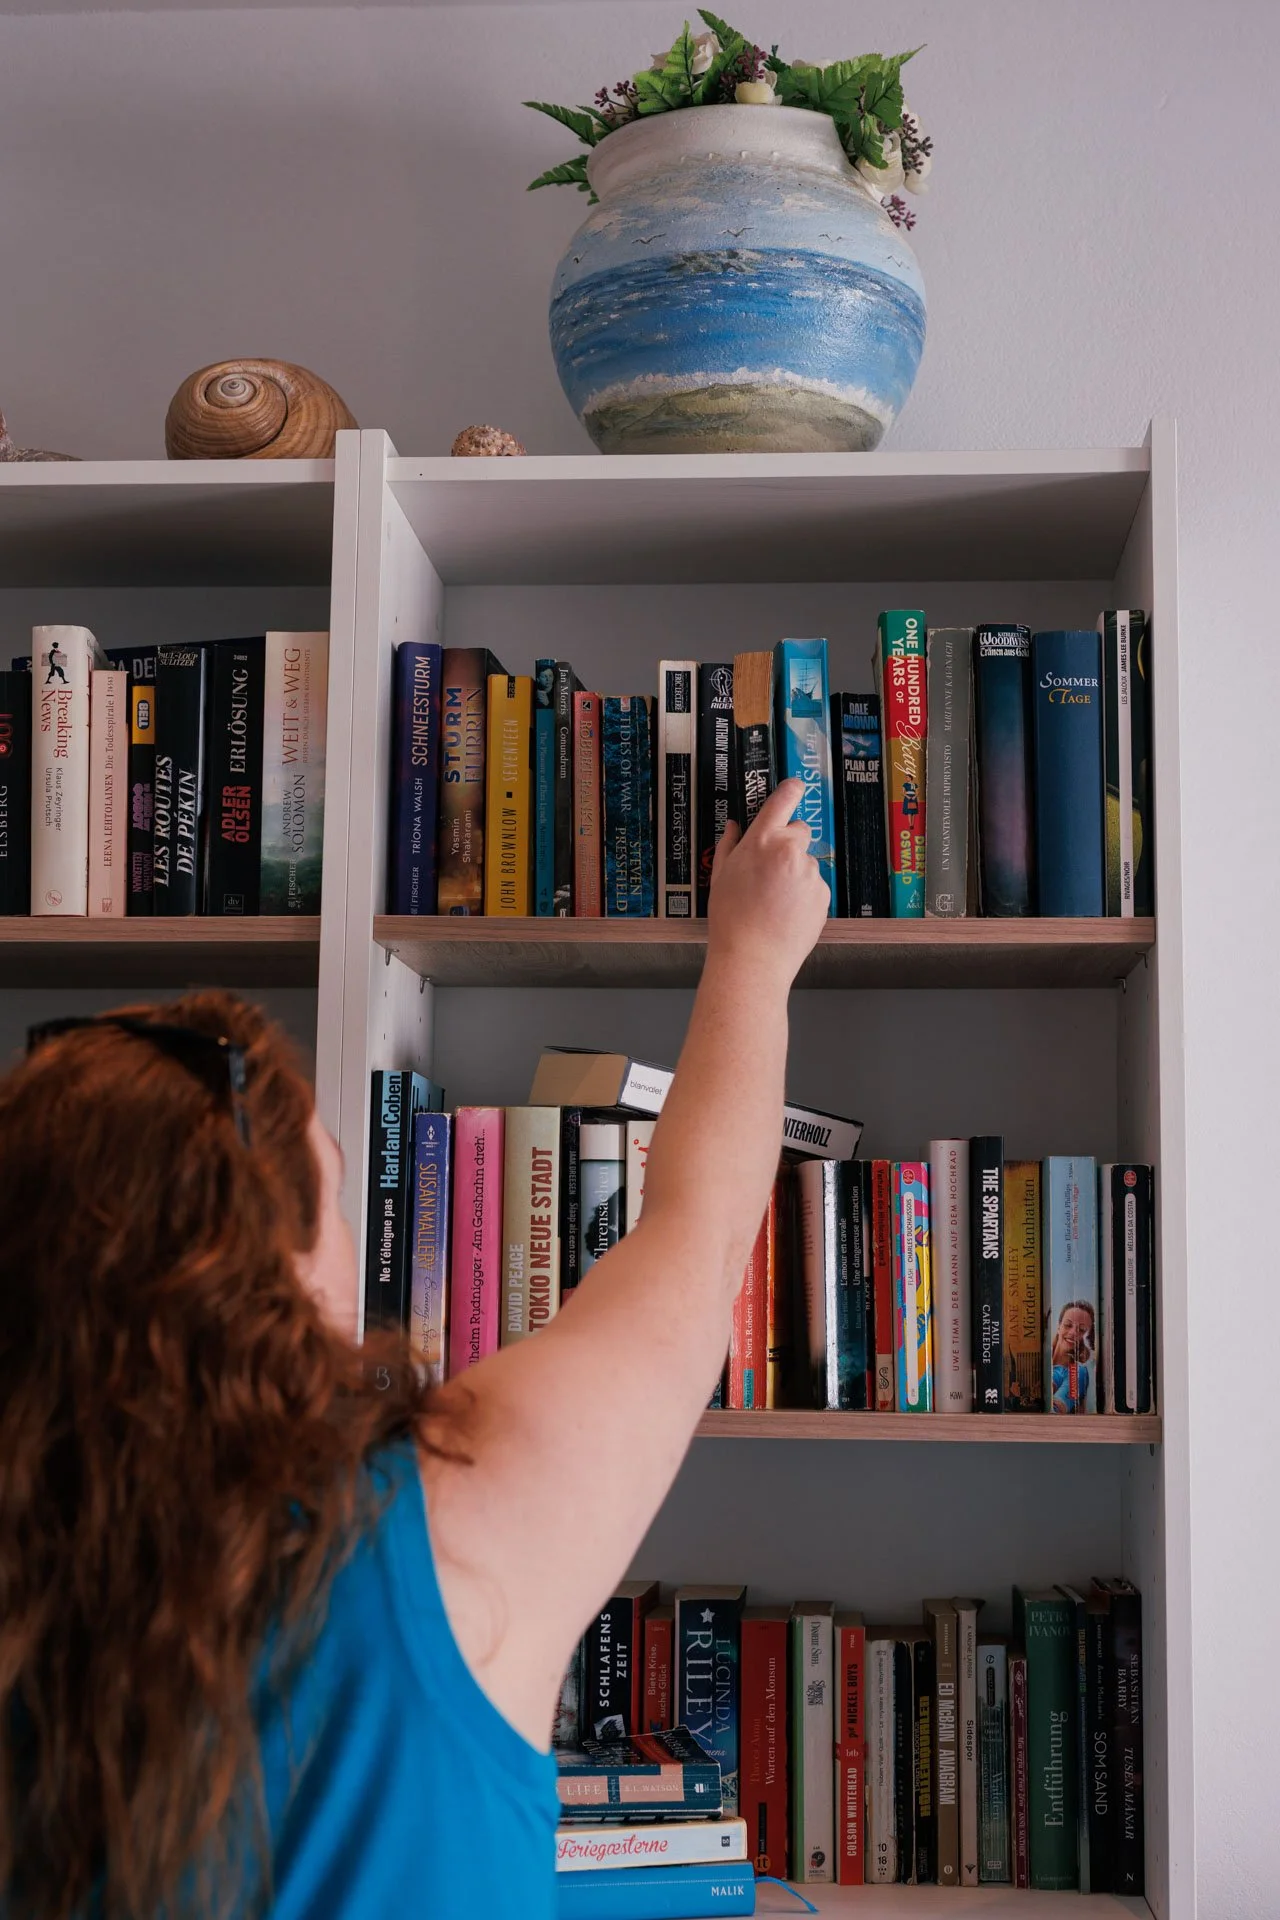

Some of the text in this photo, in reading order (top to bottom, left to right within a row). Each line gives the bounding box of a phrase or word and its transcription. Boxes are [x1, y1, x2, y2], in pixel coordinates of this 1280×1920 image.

[980, 632, 1030, 646] WOODIWISS
[980, 646, 1004, 657] Tränen
[905, 617, 922, 726] ONE HUNDRED
[1039, 671, 1099, 689] SOMMER
[1048, 688, 1092, 704] TAGE
[41, 689, 56, 732] News
[54, 689, 73, 759] Breaking
[139, 702, 148, 728] BELL
[227, 668, 249, 774] ERLÖSUNG
[281, 648, 301, 766] WEIT & WEG
[444, 687, 462, 784] STURM
[464, 687, 483, 783] FLIRREN
[559, 667, 569, 779] Jan Morris Conundrum
[843, 714, 878, 730] BROWN
[849, 702, 869, 716] DALE
[892, 637, 925, 778] YEARS OF Betty
[579, 719, 593, 774] ROBERT
[620, 716, 632, 813] TIDES OF WAR
[714, 717, 728, 792] ANTHONY HOROWITZ
[845, 759, 881, 772] PLAN OF
[45, 767, 53, 827] Ursula Prutsch
[53, 767, 63, 832] Klaus Zeyringer
[104, 700, 117, 867] LEENA LEHTOLAINEN Die Todesspirale
[409, 656, 431, 904] FISCHER TRÍONA WALSH SCHNEESTURM
[801, 732, 823, 844] Het IJSKIND
[846, 771, 879, 783] ATTACK
[155, 754, 173, 887] LES ROUTES
[173, 767, 197, 876] DE PÉKIN
[221, 785, 237, 843] ADLER
[235, 785, 252, 843] OLSEN
[282, 789, 292, 838] ANDREW
[292, 774, 306, 853] SOLOMON
[501, 719, 519, 910] JOHN BROWNLOW SEVENTEEN
[579, 778, 593, 837] RANKIN
[942, 744, 953, 871] UN INCANTEVOLE IMPREVISTO
[450, 818, 461, 856] Yasmin
[462, 810, 473, 864] Shakarami
[672, 833, 686, 860] Son
[900, 830, 913, 885] OSWALD
[914, 835, 925, 879] DEBRA
[132, 852, 143, 893] KELLERMAN
[615, 826, 629, 912] PRESSFIELD
[629, 841, 642, 895] STEVEN
[630, 1080, 663, 1096] blanvalet
[783, 1117, 833, 1148] NTERHOLZ
[380, 1075, 402, 1283] Ne pas Harlan Coben
[418, 1161, 437, 1207] SUSAN
[1064, 1183, 1073, 1208] Phillips
[416, 1210, 436, 1270] MALLERY
[528, 1147, 553, 1333] TOKIO NEUE STADT
[567, 1202, 579, 1249] Slaap een
[839, 1218, 848, 1254] en cavale
[851, 1186, 862, 1287] Une dangereuse attraction
[982, 1166, 999, 1260] THE SPARTANS
[470, 1167, 485, 1325] Rudnigger Am Gashahn
[906, 1238, 914, 1263] CHARLES
[949, 1150, 960, 1372] UWE TIMM DER MANN AUF DEM HOCHRAD
[1021, 1178, 1036, 1341] Mörder in Manhattan
[1064, 1243, 1072, 1264] Susan
[507, 1244, 524, 1333] DAVID PEACE
[1008, 1246, 1019, 1341] JANE SMILEY
[745, 1303, 753, 1336] Roberts
[981, 1303, 991, 1364] CARTLEDGE
[991, 1320, 1000, 1346] PAUL
[599, 1612, 611, 1708] SCHLAFENS
[616, 1642, 627, 1679] ZEIT
[647, 1671, 656, 1696] Biete
[686, 1628, 713, 1745] RILEY
[715, 1639, 731, 1734] LUCINDA
[1130, 1653, 1139, 1725] SEBASTIAN
[657, 1663, 667, 1718] suche Glück
[1096, 1685, 1104, 1720] Michaels
[1117, 1668, 1128, 1711] BARRY
[765, 1657, 776, 1785] Warten auf den Monsun
[938, 1682, 956, 1805] ED McBAIN ANAGRAM
[965, 1719, 974, 1761] Sidespor
[642, 1784, 680, 1792] WATSON
[847, 1663, 858, 1857] COLSON WHITEHEAD NICKEL BOYS
[1043, 1711, 1069, 1828] Entführung
[1094, 1731, 1108, 1815] SOM SAND
[567, 1784, 602, 1796] LIFE
[1124, 1747, 1136, 1840] TUSEN MÅNAR
[557, 1834, 669, 1861] Feriegæsterne
[877, 1843, 887, 1852] 10
[877, 1855, 887, 1865] 18
[1018, 1830, 1026, 1857] MATHER
[712, 1886, 745, 1897] MALIK
